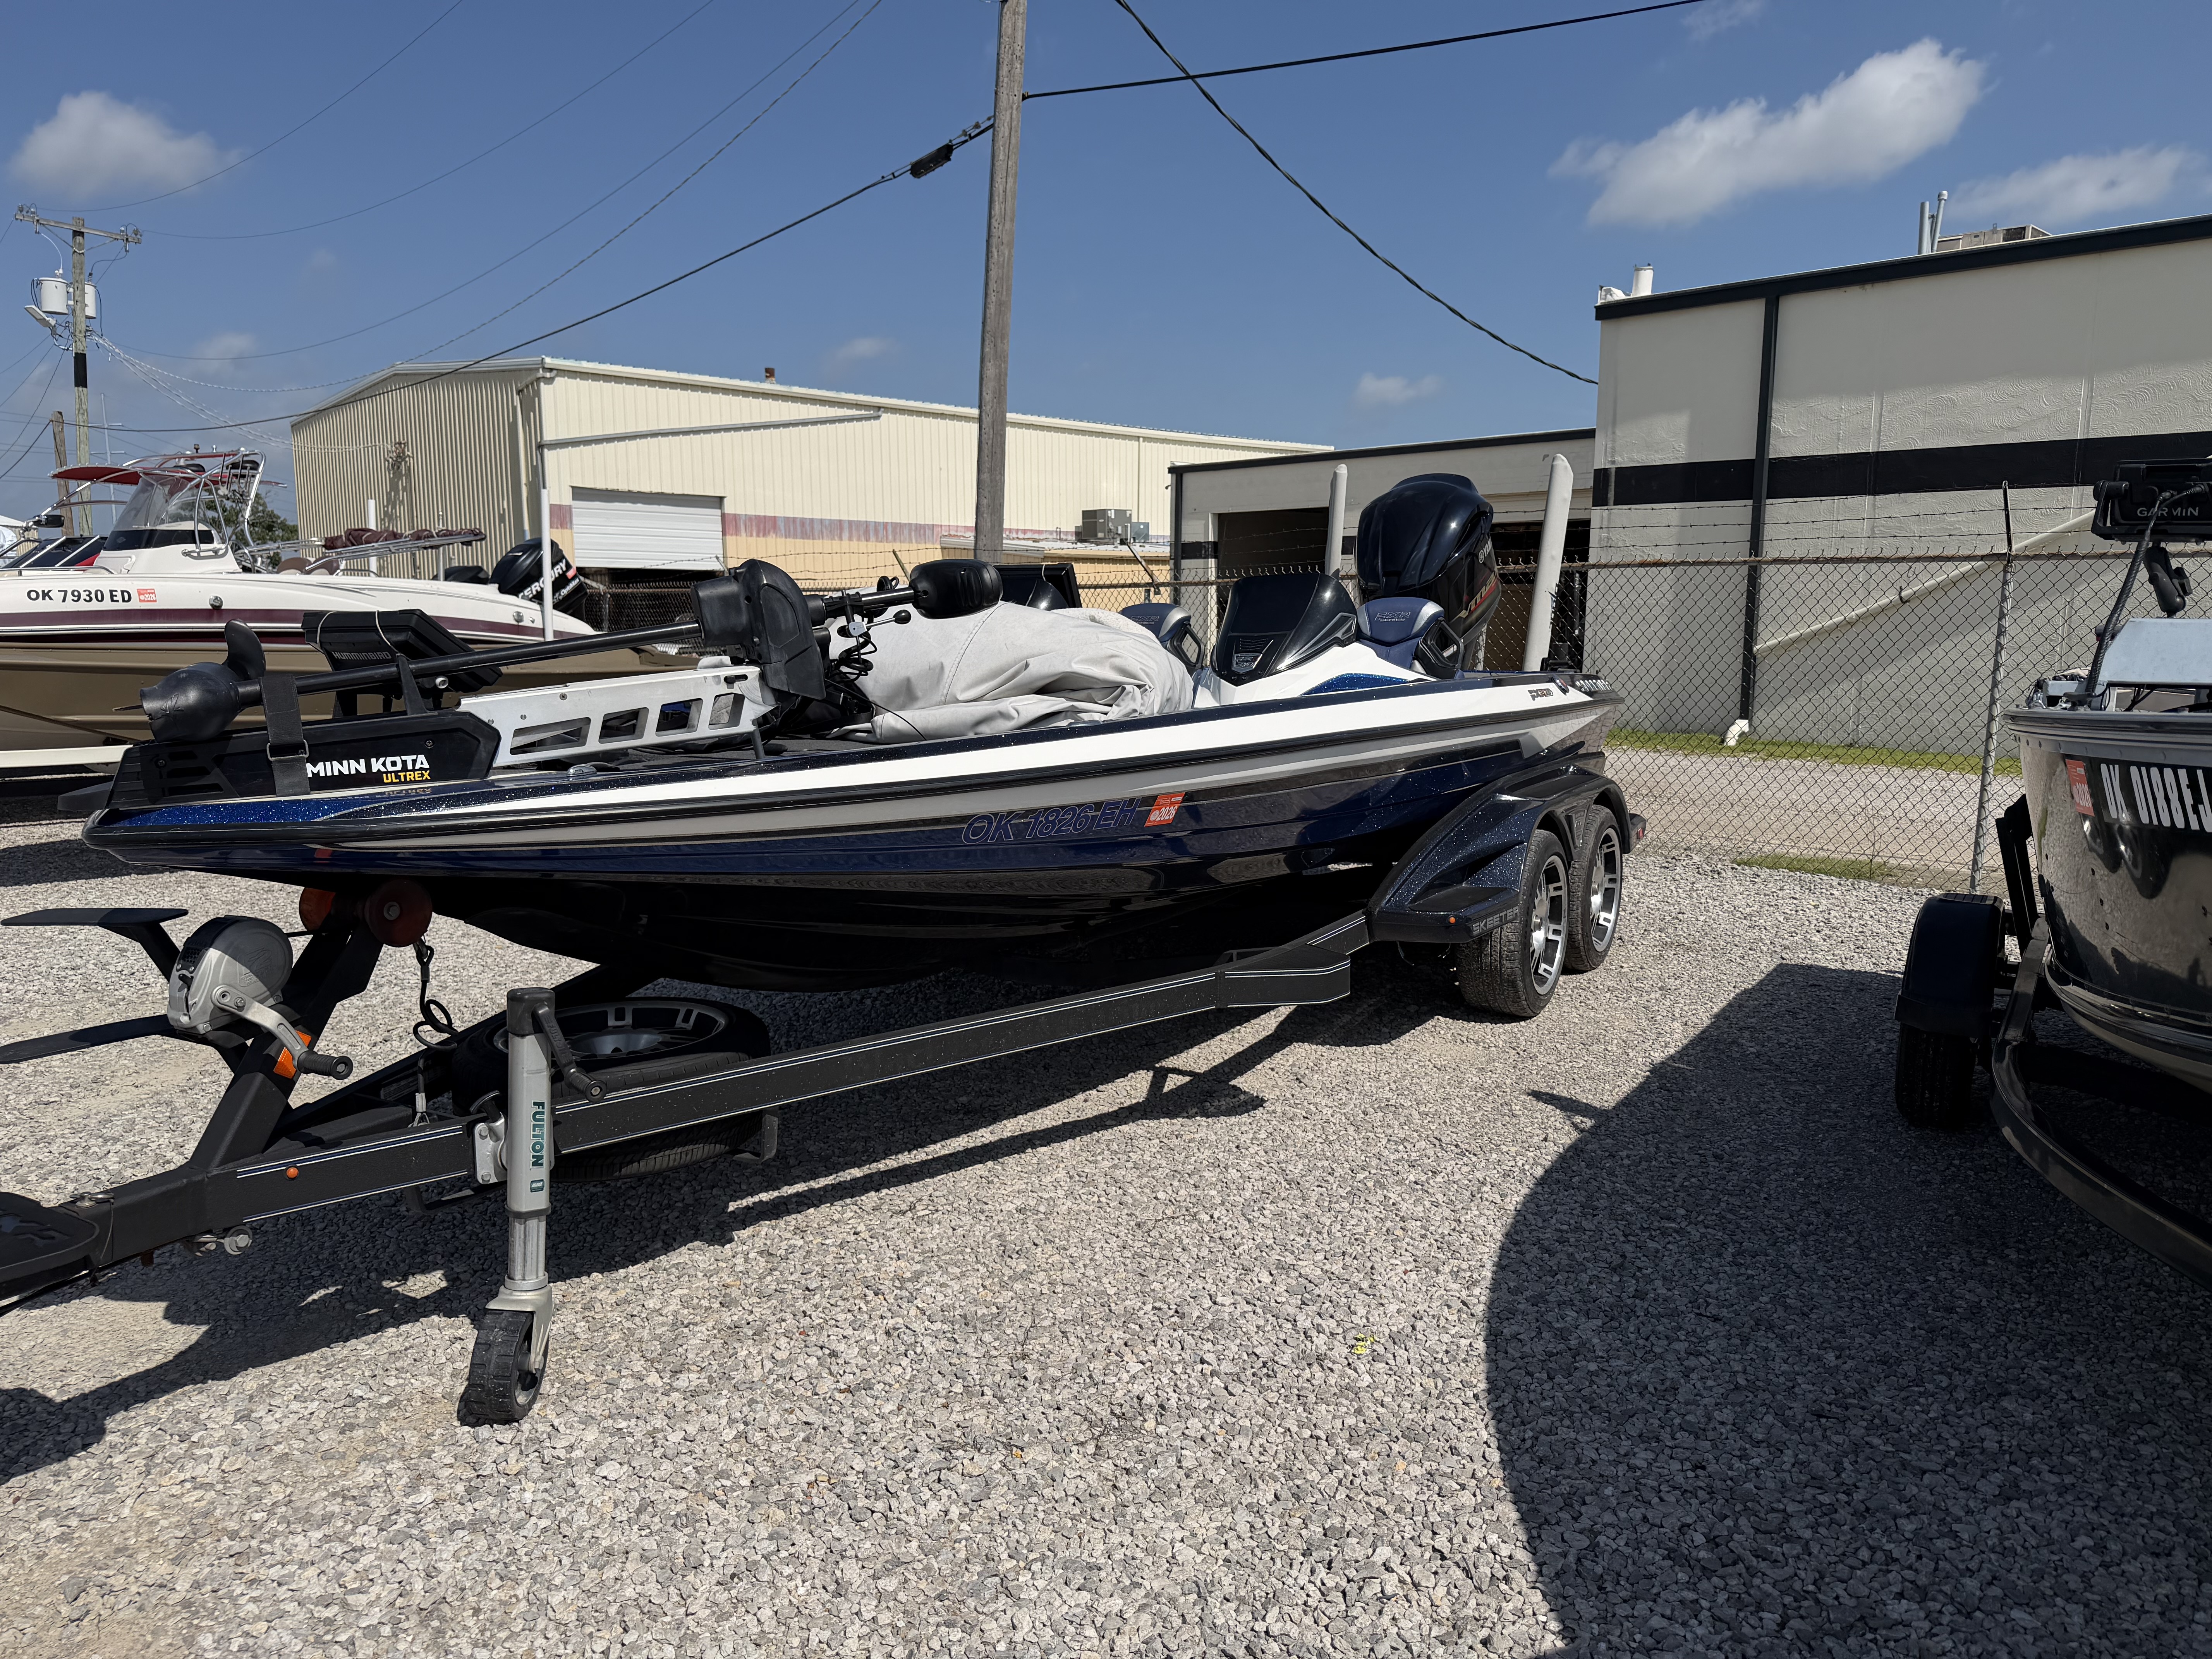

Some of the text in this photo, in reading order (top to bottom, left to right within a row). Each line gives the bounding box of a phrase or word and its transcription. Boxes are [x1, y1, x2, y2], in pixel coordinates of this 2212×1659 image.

[2137, 507, 2199, 517] GARMIN
[27, 589, 132, 603] OK 7930 ED
[331, 651, 392, 660] HUMMINBIRD
[306, 754, 430, 778] MINN KOTA
[383, 770, 431, 783] ULTREX
[2100, 763, 2130, 822] OK
[962, 797, 1142, 845] OK 1826 EH
[1156, 806, 1178, 821] 2026
[1473, 906, 1519, 935] SKEETER
[530, 1100, 546, 1168] FULTON
